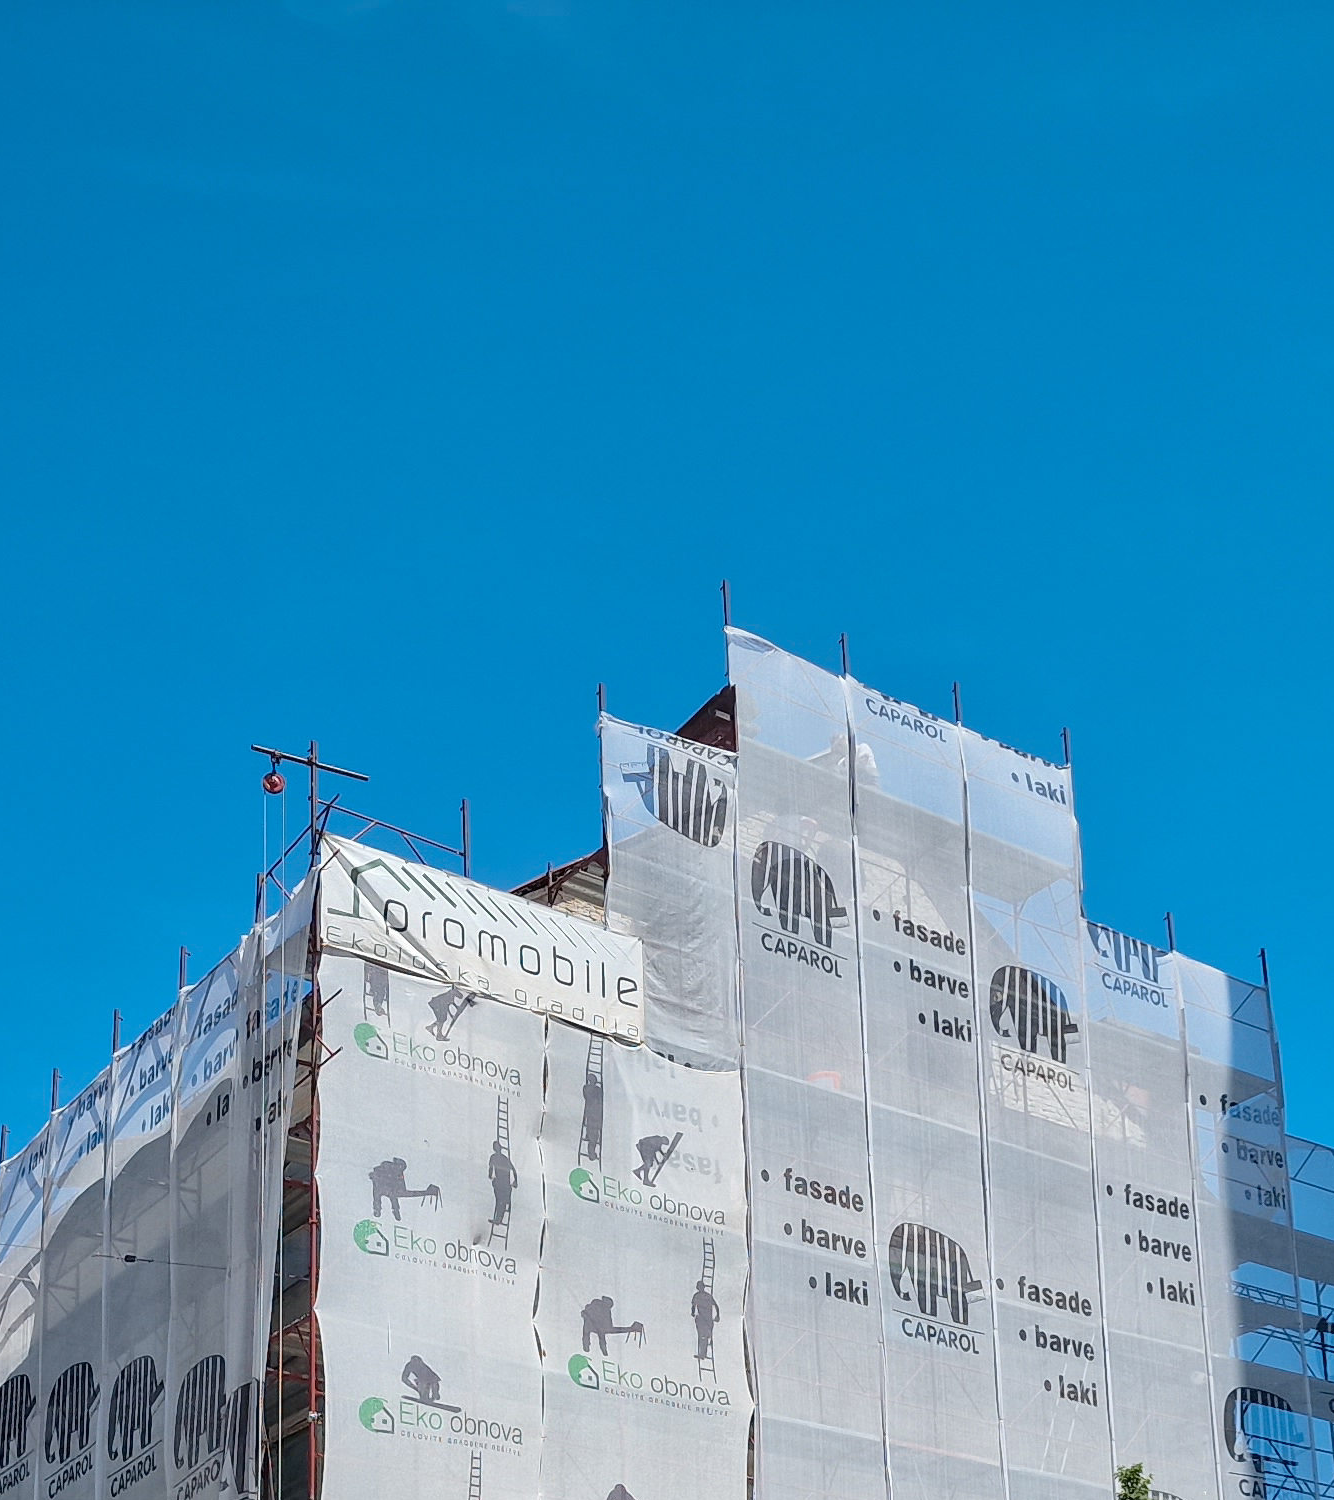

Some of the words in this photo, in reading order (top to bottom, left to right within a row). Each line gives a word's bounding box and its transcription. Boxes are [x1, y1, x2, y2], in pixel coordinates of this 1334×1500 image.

[864, 696, 948, 743] CAPAROL
[1025, 771, 1068, 806] laki
[383, 898, 640, 1008] promobile
[893, 910, 967, 957] fasade
[760, 932, 843, 979] CAPAROL
[909, 959, 970, 1001] barve
[1102, 971, 1169, 1008] CAPAROL
[932, 1008, 974, 1043] laki
[203, 1036, 237, 1084] barv
[393, 1032, 436, 1061] Eko
[443, 1046, 522, 1087] obnova
[1000, 1053, 1075, 1094] CAPAROL
[149, 1098, 171, 1131] lak
[1220, 1093, 1281, 1127] fasade
[1236, 1138, 1284, 1169] barve
[603, 1175, 643, 1205] Eko
[649, 1193, 726, 1226] obnova
[783, 1168, 865, 1212] fasade
[1123, 1184, 1191, 1221] fasade
[1257, 1184, 1287, 1211] laki
[394, 1225, 437, 1254] Eko
[444, 1239, 518, 1275] obnova
[801, 1220, 867, 1259] barve
[1137, 1230, 1193, 1262] barve
[824, 1272, 869, 1308] laki
[1017, 1276, 1093, 1317] fasade
[1158, 1277, 1197, 1308] laki
[900, 1317, 981, 1355] CAPAROL
[1034, 1325, 1096, 1362] barve
[602, 1360, 643, 1389] Eko
[650, 1375, 732, 1406] obnova
[1057, 1376, 1098, 1408] laki
[399, 1400, 443, 1430] Eko
[450, 1410, 524, 1445] obnova
[48, 1452, 94, 1500] CAPAROL
[110, 1451, 158, 1498] CAPAROL
